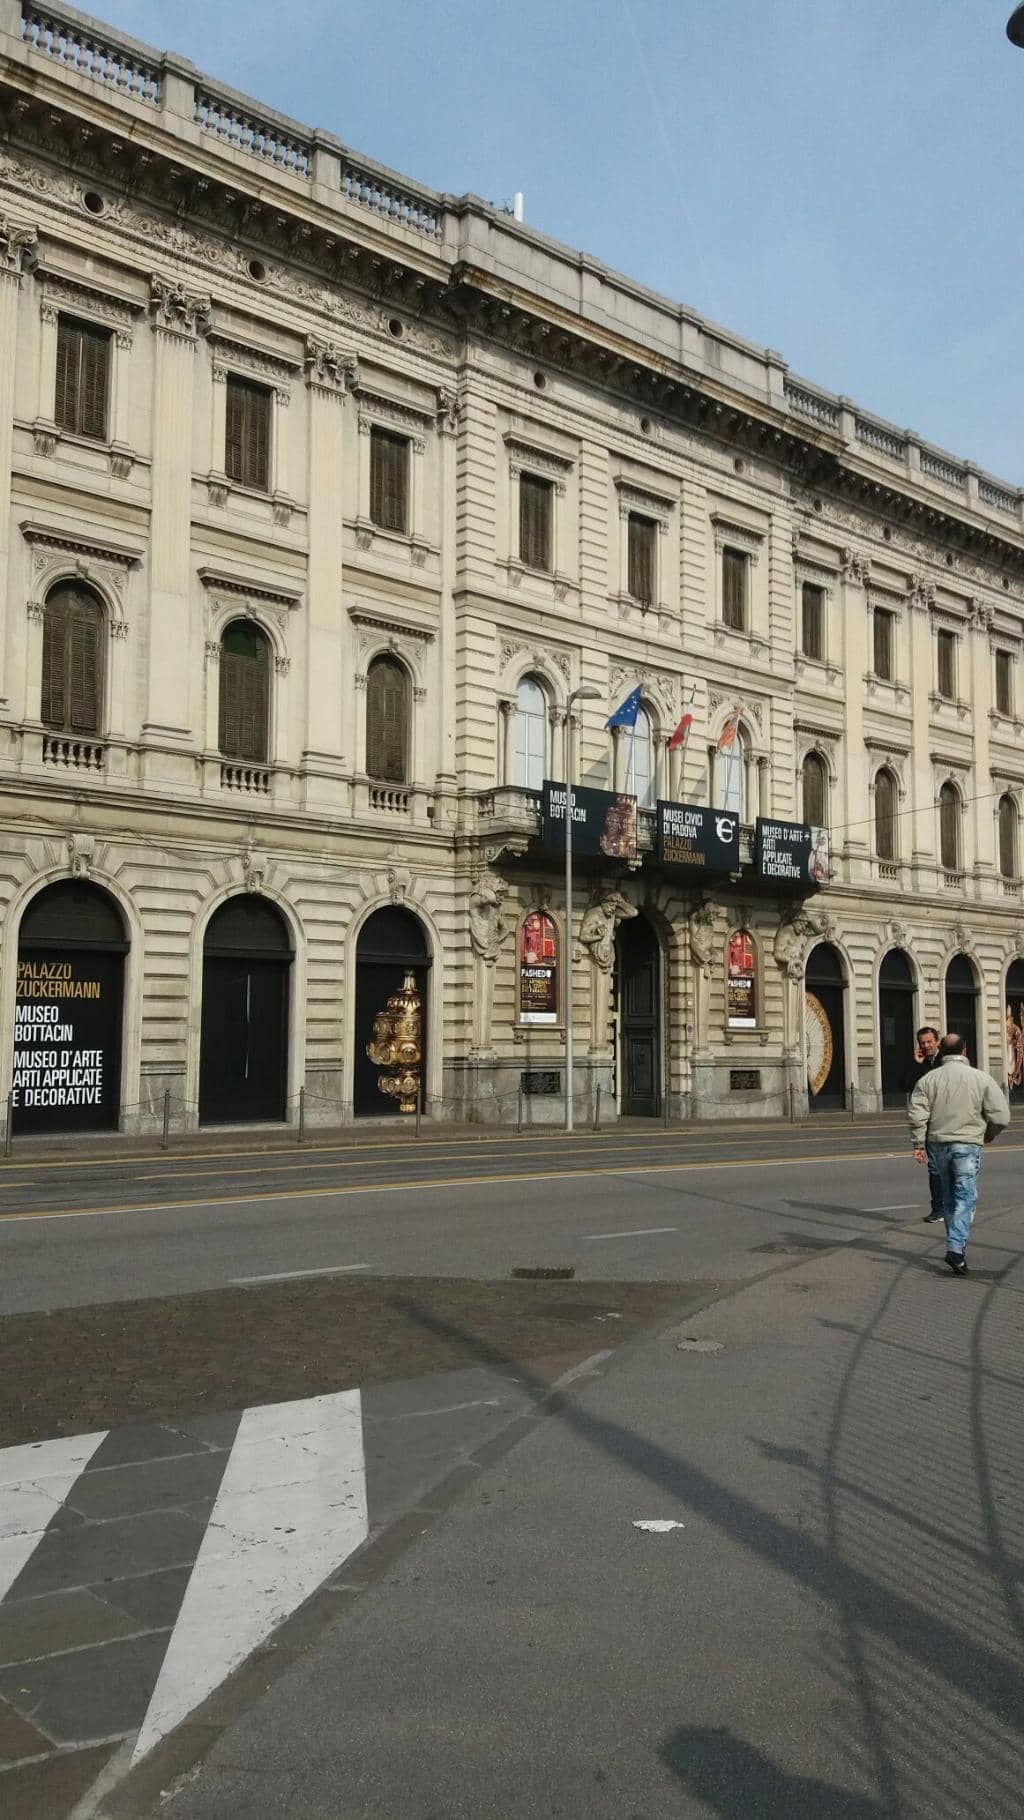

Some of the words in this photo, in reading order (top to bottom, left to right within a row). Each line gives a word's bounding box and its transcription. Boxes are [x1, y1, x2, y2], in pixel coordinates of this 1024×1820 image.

[549, 790, 576, 807] MUSO
[550, 804, 586, 822] BOTACIN
[663, 808, 684, 824] MUSEI
[684, 812, 703, 827] CIVICI
[663, 822, 671, 835] DI
[671, 823, 698, 840] PADOVA
[762, 825, 781, 840] MUSEO
[783, 828, 803, 842] D'ARTE
[663, 836, 692, 851] PALAZZO
[763, 838, 776, 851] ARTI
[663, 848, 706, 865] ZUCKERMANN
[763, 850, 792, 865] APPLICATE
[763, 862, 767, 875] E
[767, 864, 800, 878] DECORATIVE
[17, 961, 72, 979] PALAZZO
[16, 980, 101, 999] ZUCKERMANN
[15, 1005, 59, 1023] MUSEO
[14, 1024, 73, 1042] BOTTACIN
[13, 1050, 57, 1069] MUSEO
[61, 1050, 103, 1068] D'ARTE
[12, 1070, 40, 1088] ARTI
[42, 1068, 103, 1087] APPLICATE
[12, 1089, 20, 1108] E
[25, 1087, 102, 1107] DECORATIVE
